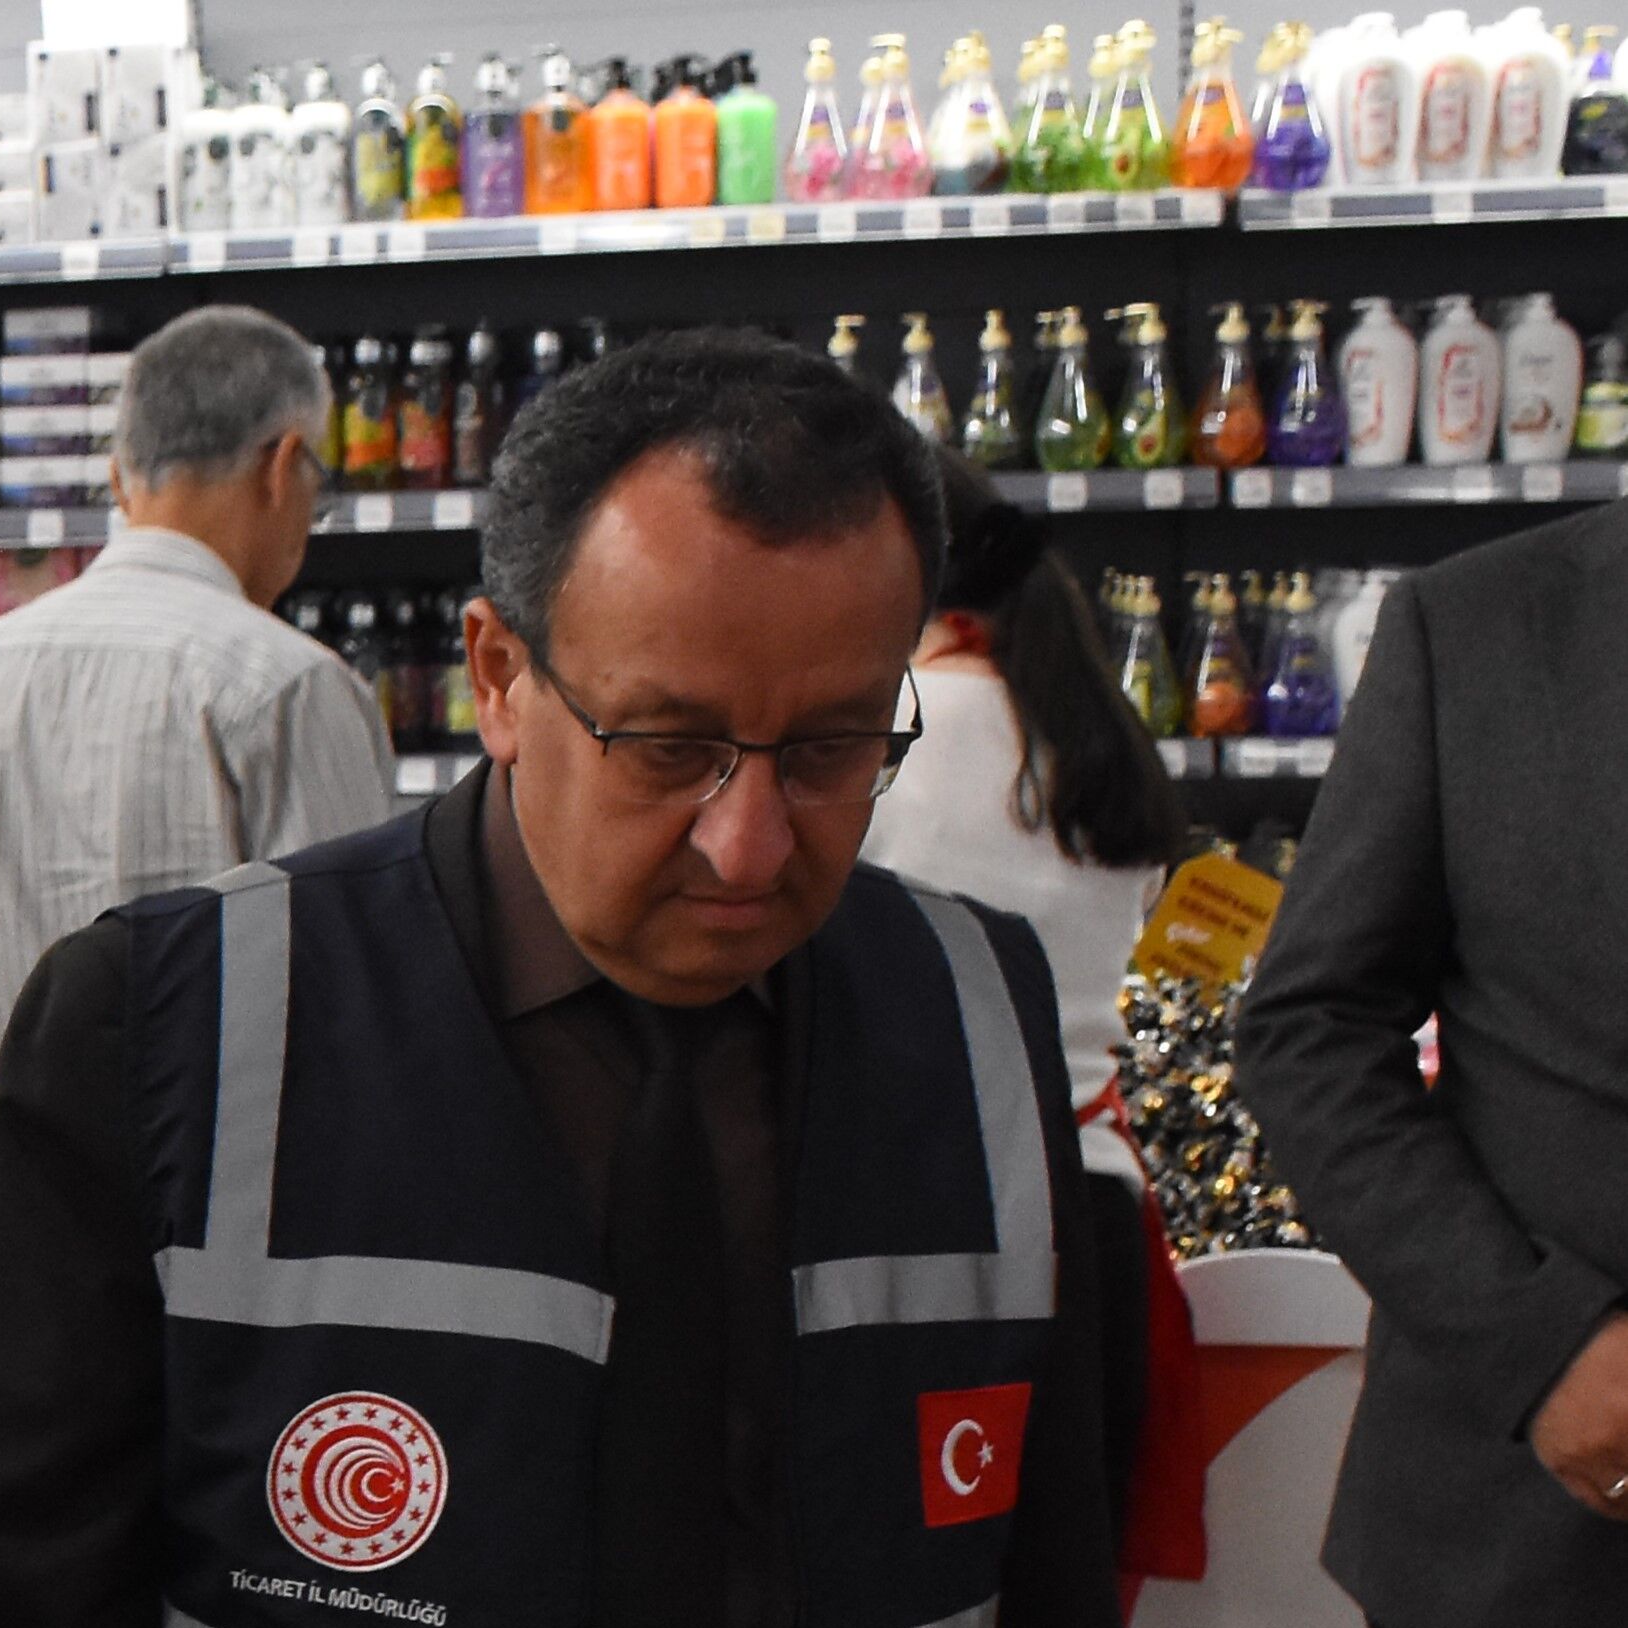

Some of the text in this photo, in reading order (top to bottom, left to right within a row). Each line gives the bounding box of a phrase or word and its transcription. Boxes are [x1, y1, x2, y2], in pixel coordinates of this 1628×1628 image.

[229, 1568, 447, 1628] TİCARET İL MÜDÜRLÜĞÜ
